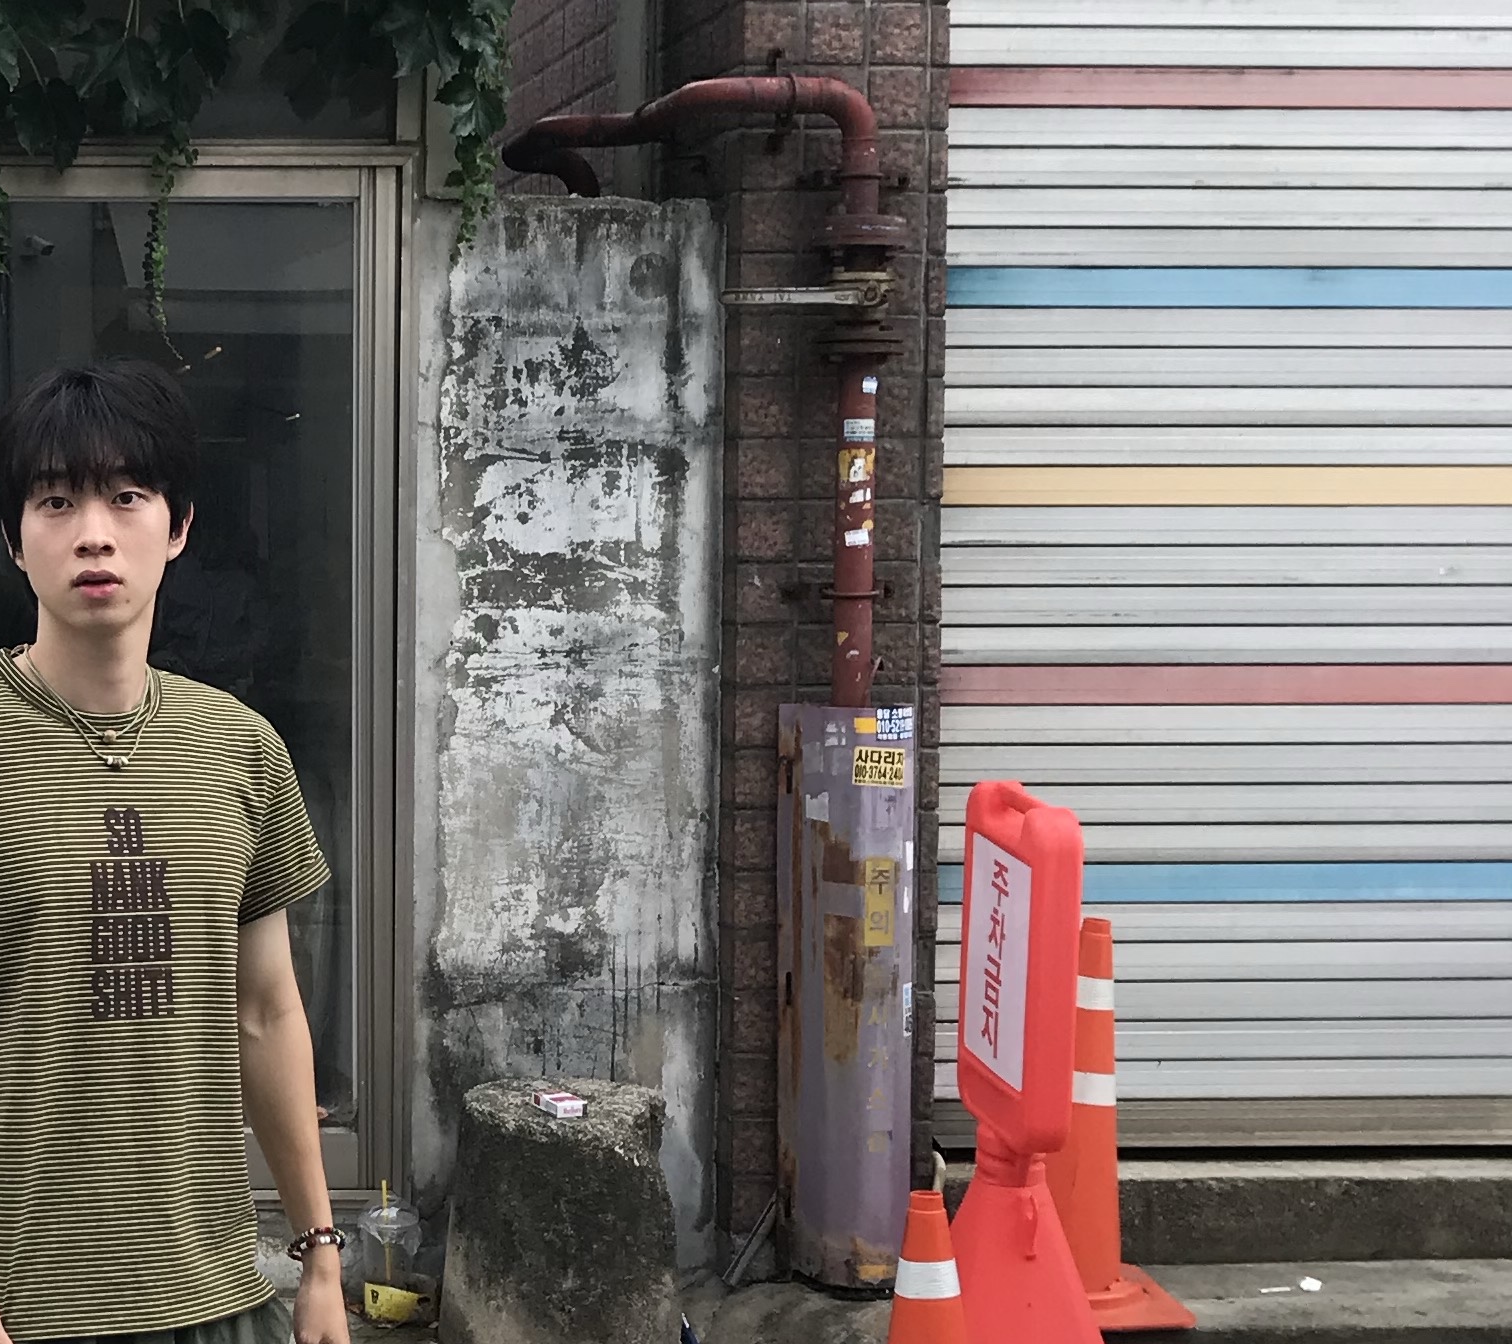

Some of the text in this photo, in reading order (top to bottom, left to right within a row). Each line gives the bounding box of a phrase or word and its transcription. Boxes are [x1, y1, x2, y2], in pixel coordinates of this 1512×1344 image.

[103, 807, 144, 855] SO
[91, 916, 172, 962] GOOD
[981, 859, 1009, 1059] 주차금지
